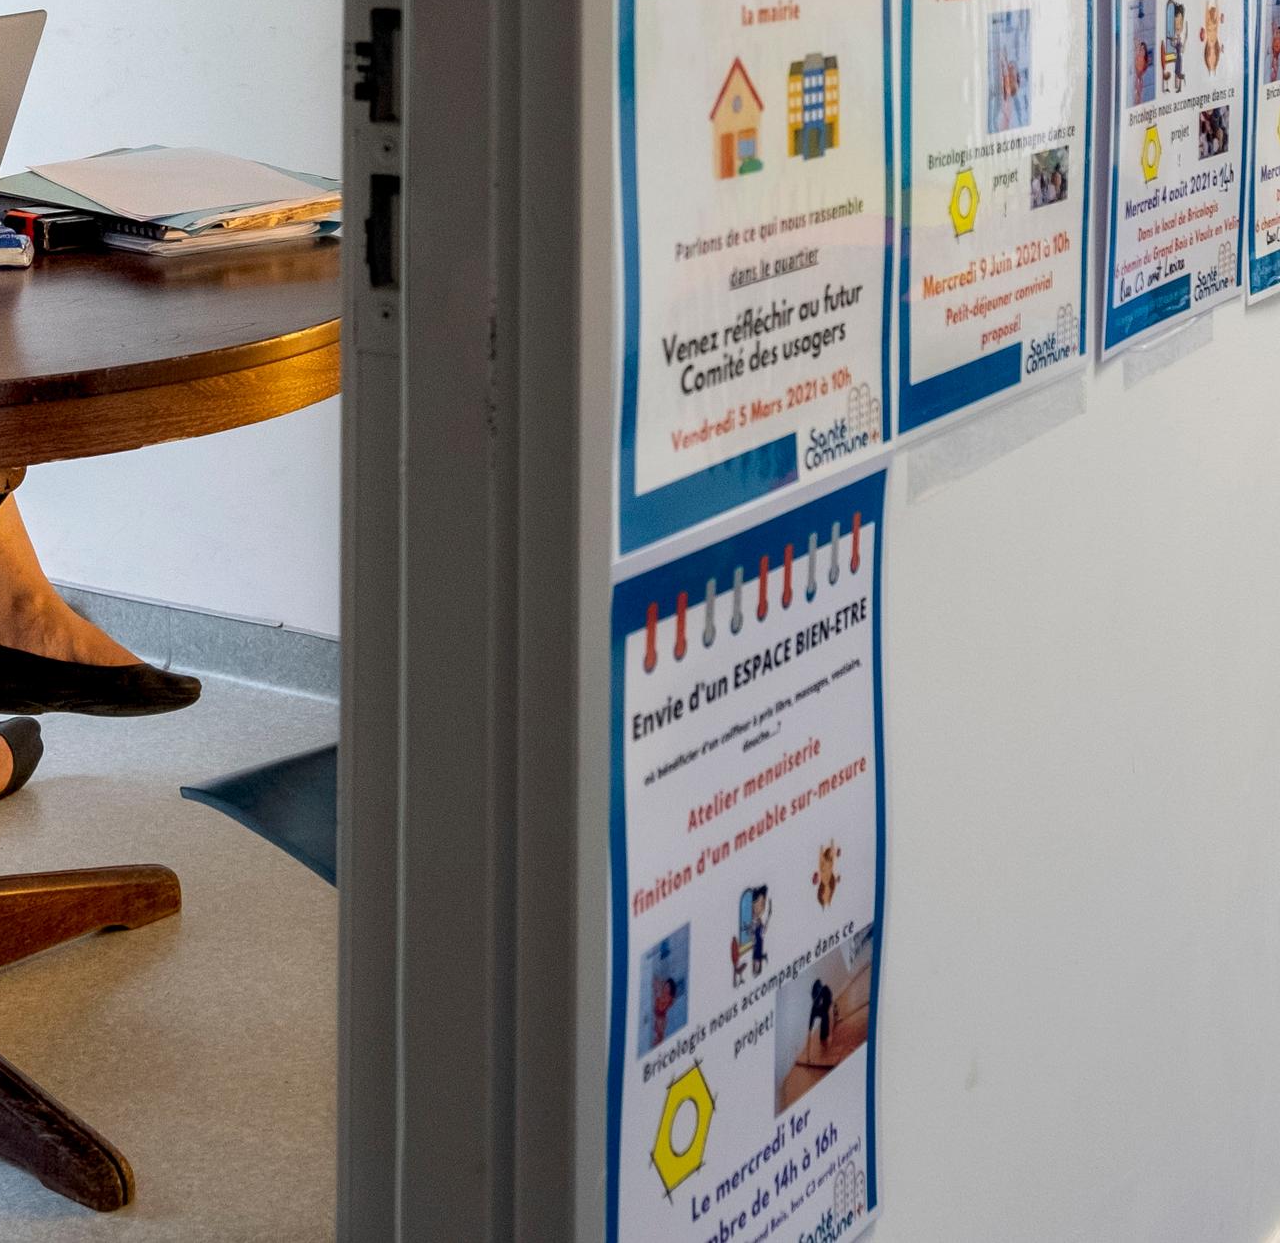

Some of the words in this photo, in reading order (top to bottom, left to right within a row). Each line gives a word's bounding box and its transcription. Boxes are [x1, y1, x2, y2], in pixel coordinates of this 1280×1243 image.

[1125, 187, 1160, 220] Mercredi
[1169, 179, 1188, 203] août
[1190, 171, 1211, 195] 2021
[923, 260, 977, 300] Mercredi
[980, 259, 987, 280] 9
[990, 255, 1013, 278] Juin
[1015, 240, 1042, 270] 2021
[1052, 231, 1070, 256] 10h
[945, 286, 1013, 327] Petit-déjeuner
[1015, 270, 1054, 303] convivial
[662, 332, 720, 367] Venez
[724, 298, 794, 346] réfléchir
[799, 297, 820, 322] au
[823, 282, 863, 313] futur
[680, 347, 744, 396] Comité
[749, 341, 779, 372] des
[783, 321, 847, 362] usagers
[1026, 343, 1071, 375] Commune
[1030, 331, 1057, 358] Santé
[671, 409, 735, 454] Vendredi
[738, 403, 748, 428] 5
[751, 397, 783, 422] Mars
[786, 379, 818, 410] 2021
[821, 373, 829, 396] à
[831, 365, 852, 392] 10h
[810, 419, 848, 450] Santé
[805, 430, 869, 472] Commune
[632, 695, 684, 743] Envie
[689, 675, 728, 713] d'un
[733, 639, 792, 692] ESPACE
[795, 597, 868, 657] BIEN-ETRE
[687, 786, 740, 834] Atelier
[742, 735, 821, 800] menuiserie
[632, 862, 692, 918] finition
[696, 844, 731, 882] d'un
[734, 802, 788, 853] meuble
[790, 755, 868, 818] sur-mesure
[642, 1023, 707, 1083] Bricologis
[709, 1004, 739, 1036] nous
[740, 947, 812, 1012] accompagne
[813, 930, 842, 959] dans
[843, 919, 855, 938] ce
[733, 1012, 775, 1058] projet!
[691, 1192, 710, 1223] Le
[715, 1127, 786, 1205] mercredi
[789, 1108, 811, 1139] 1er
[751, 1187, 770, 1218] de
[774, 1159, 798, 1197] 14h
[802, 1147, 811, 1171] à
[815, 1121, 838, 1158] 16h
